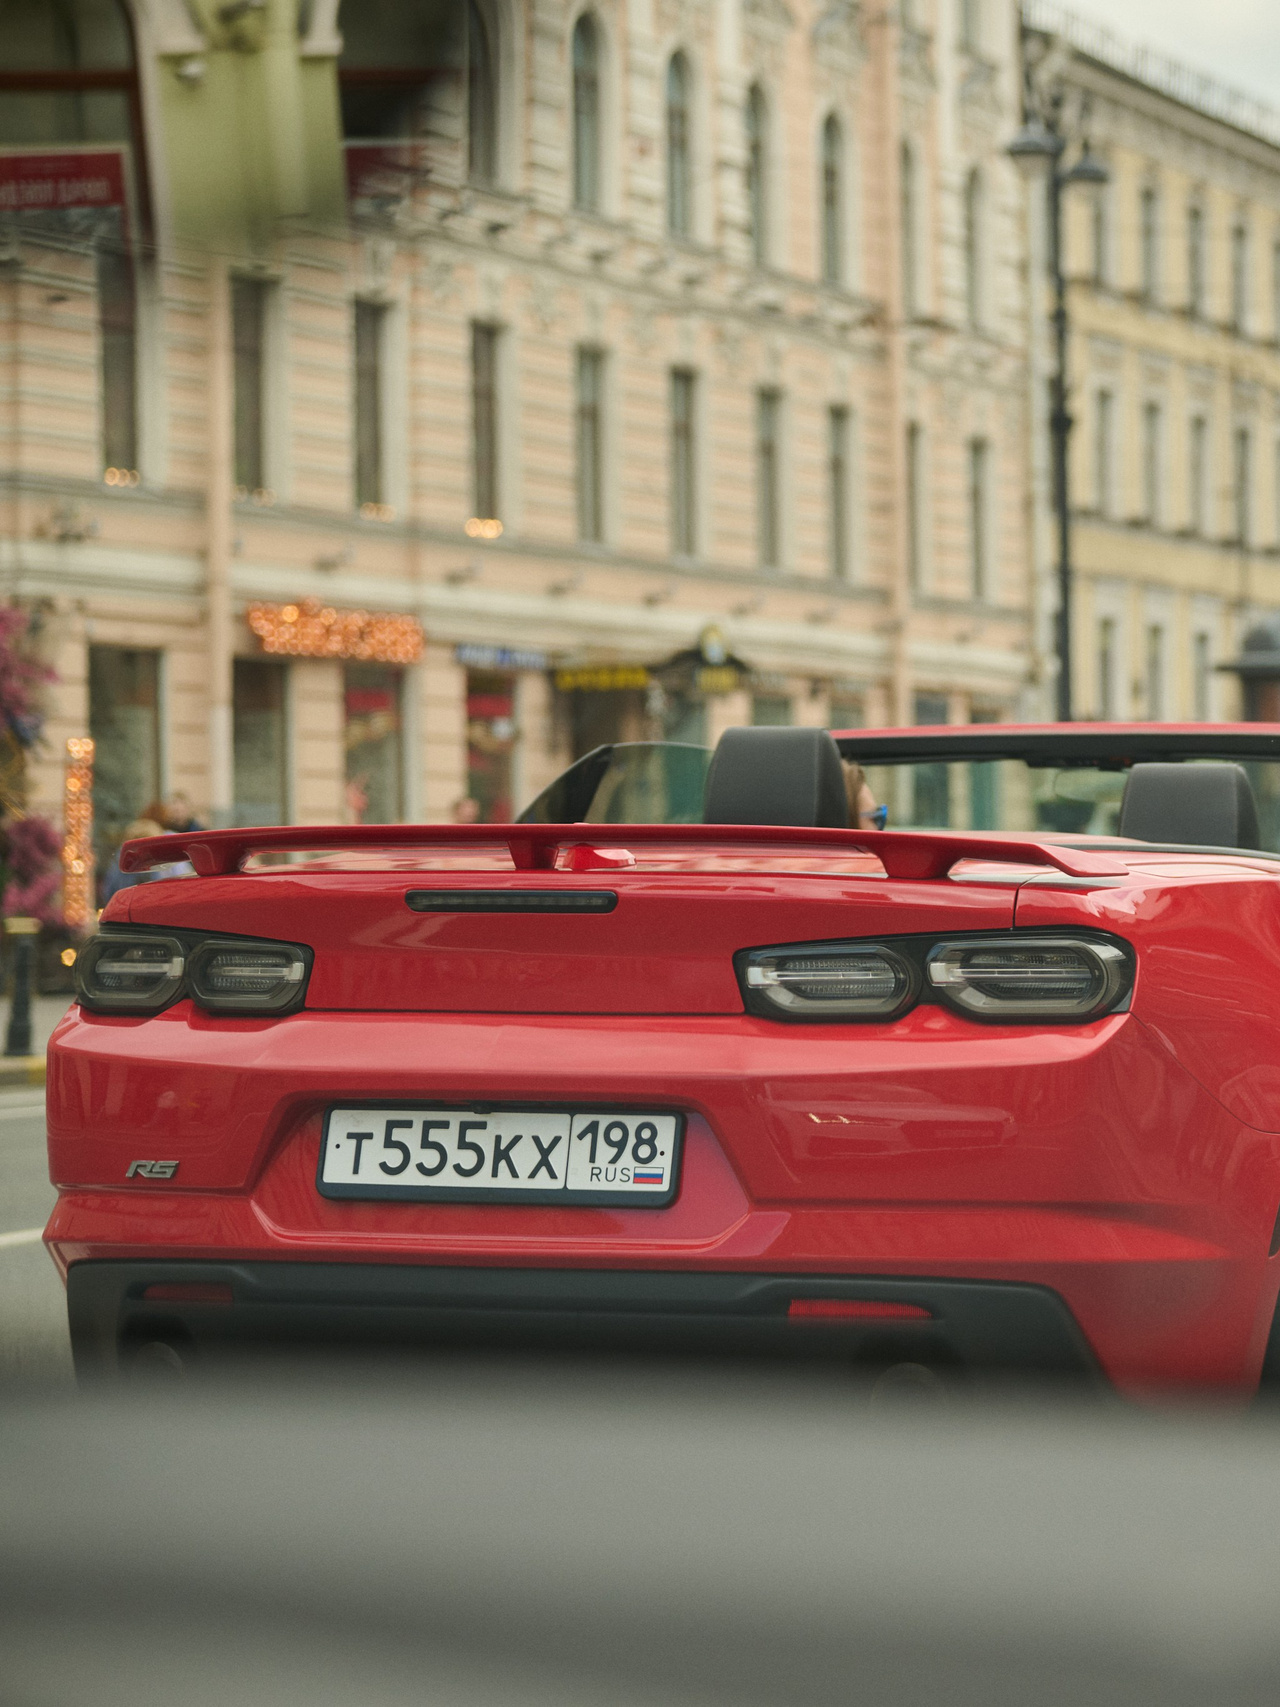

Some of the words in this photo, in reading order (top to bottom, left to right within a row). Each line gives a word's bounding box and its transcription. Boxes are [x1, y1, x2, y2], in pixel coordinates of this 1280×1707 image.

[576, 1121, 658, 1164] 198
[125, 1160, 179, 1179] RS
[590, 1166, 631, 1183] RUS
